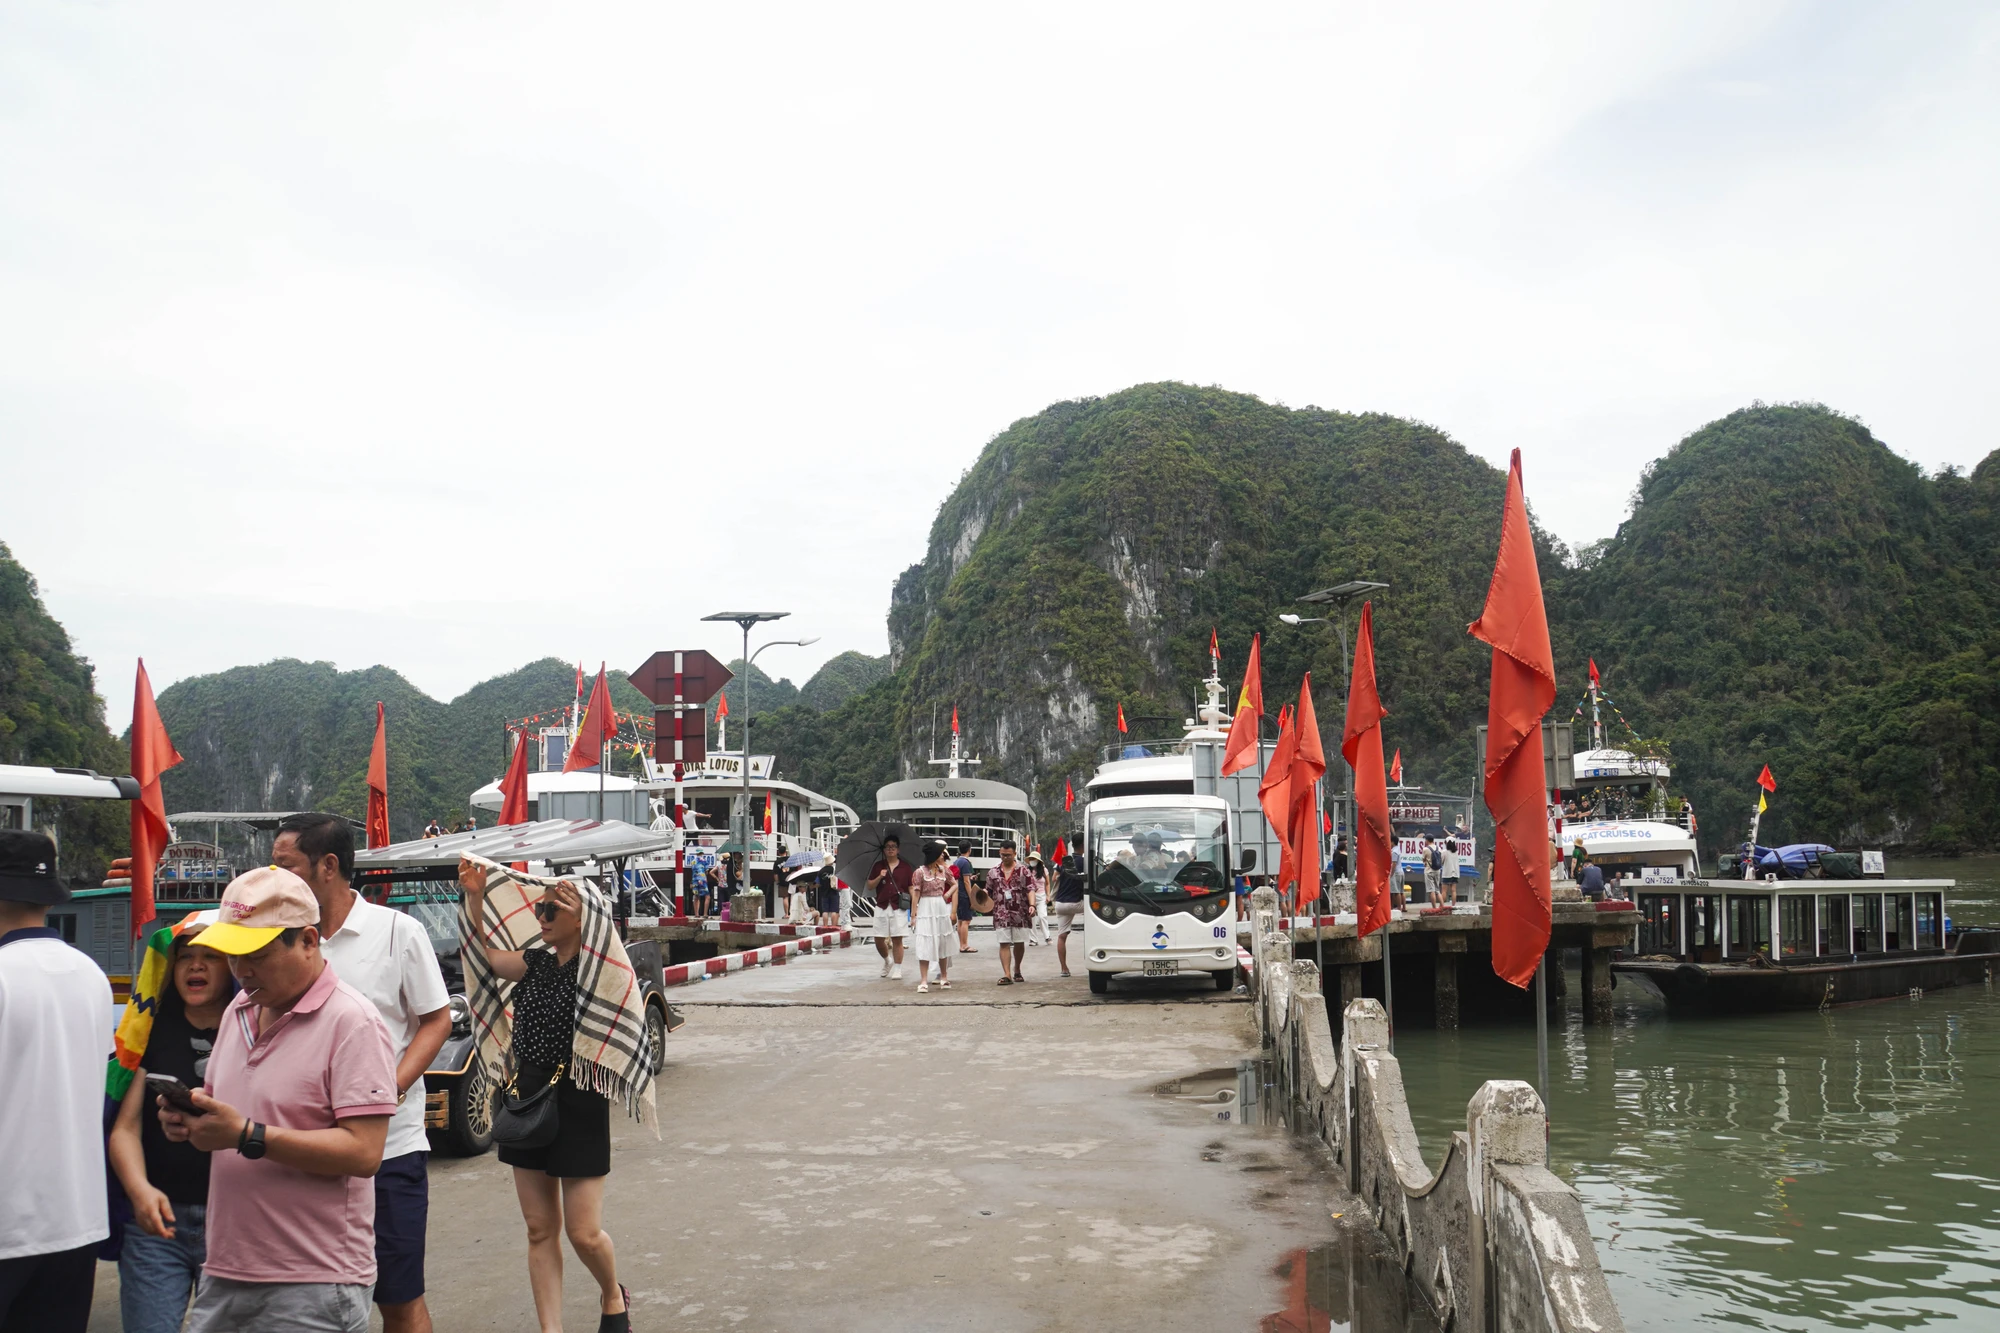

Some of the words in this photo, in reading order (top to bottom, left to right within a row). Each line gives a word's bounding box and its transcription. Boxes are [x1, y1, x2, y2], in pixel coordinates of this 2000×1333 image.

[683, 760, 705, 773] OYAL
[710, 758, 739, 773] LOTUS
[913, 791, 940, 799] CALISA
[1213, 926, 1227, 939] 06
[1151, 961, 1171, 969] 15HC
